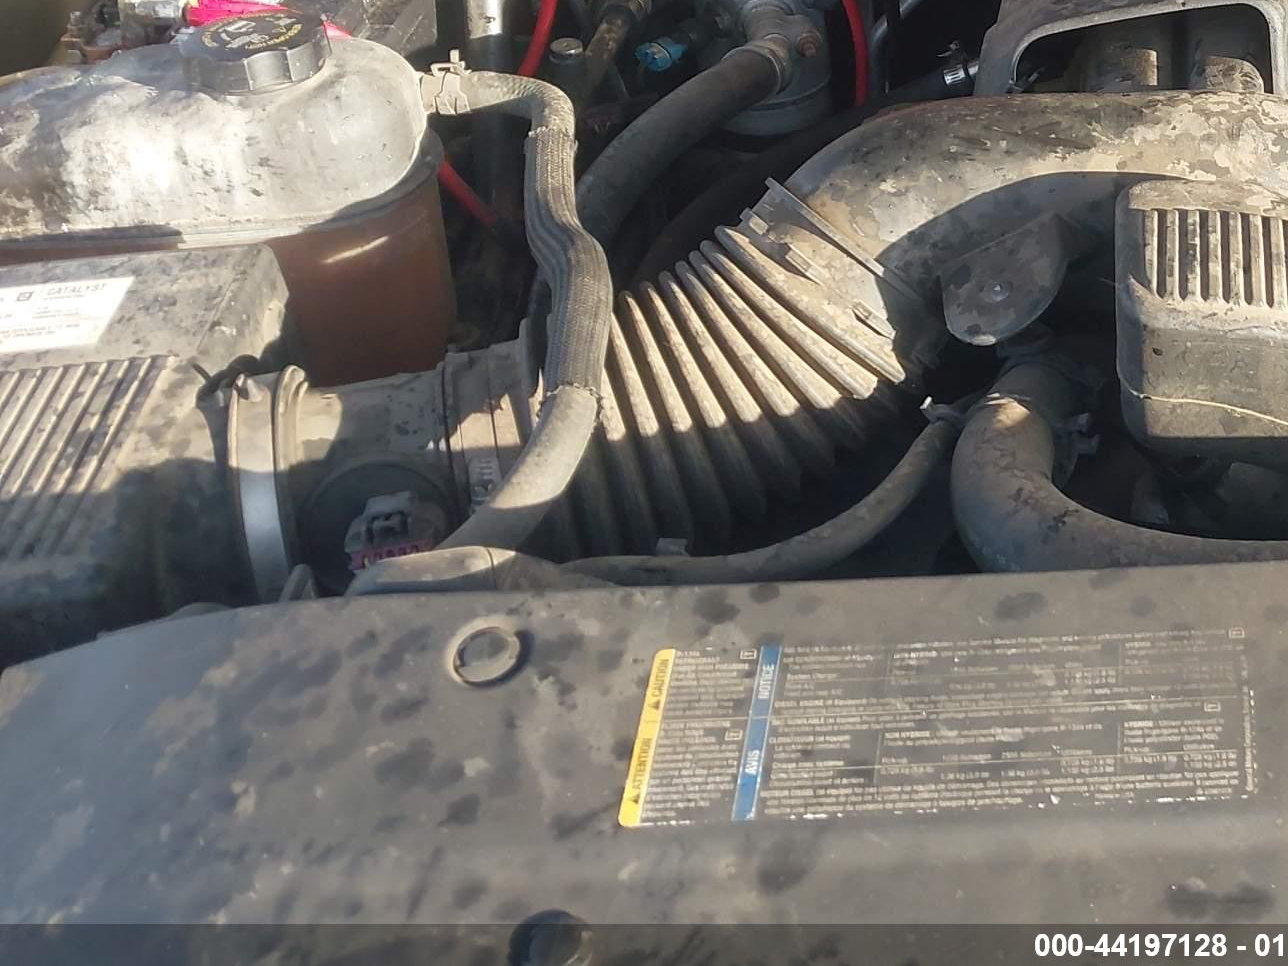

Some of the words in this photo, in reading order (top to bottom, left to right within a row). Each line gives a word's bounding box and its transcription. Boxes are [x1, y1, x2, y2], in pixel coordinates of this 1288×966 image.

[47, 282, 107, 296] CATALYST
[651, 658, 670, 698] CAUTION
[757, 663, 775, 700] NOTICE
[632, 736, 653, 790] ATTENTION
[744, 749, 760, 776] AVIS
